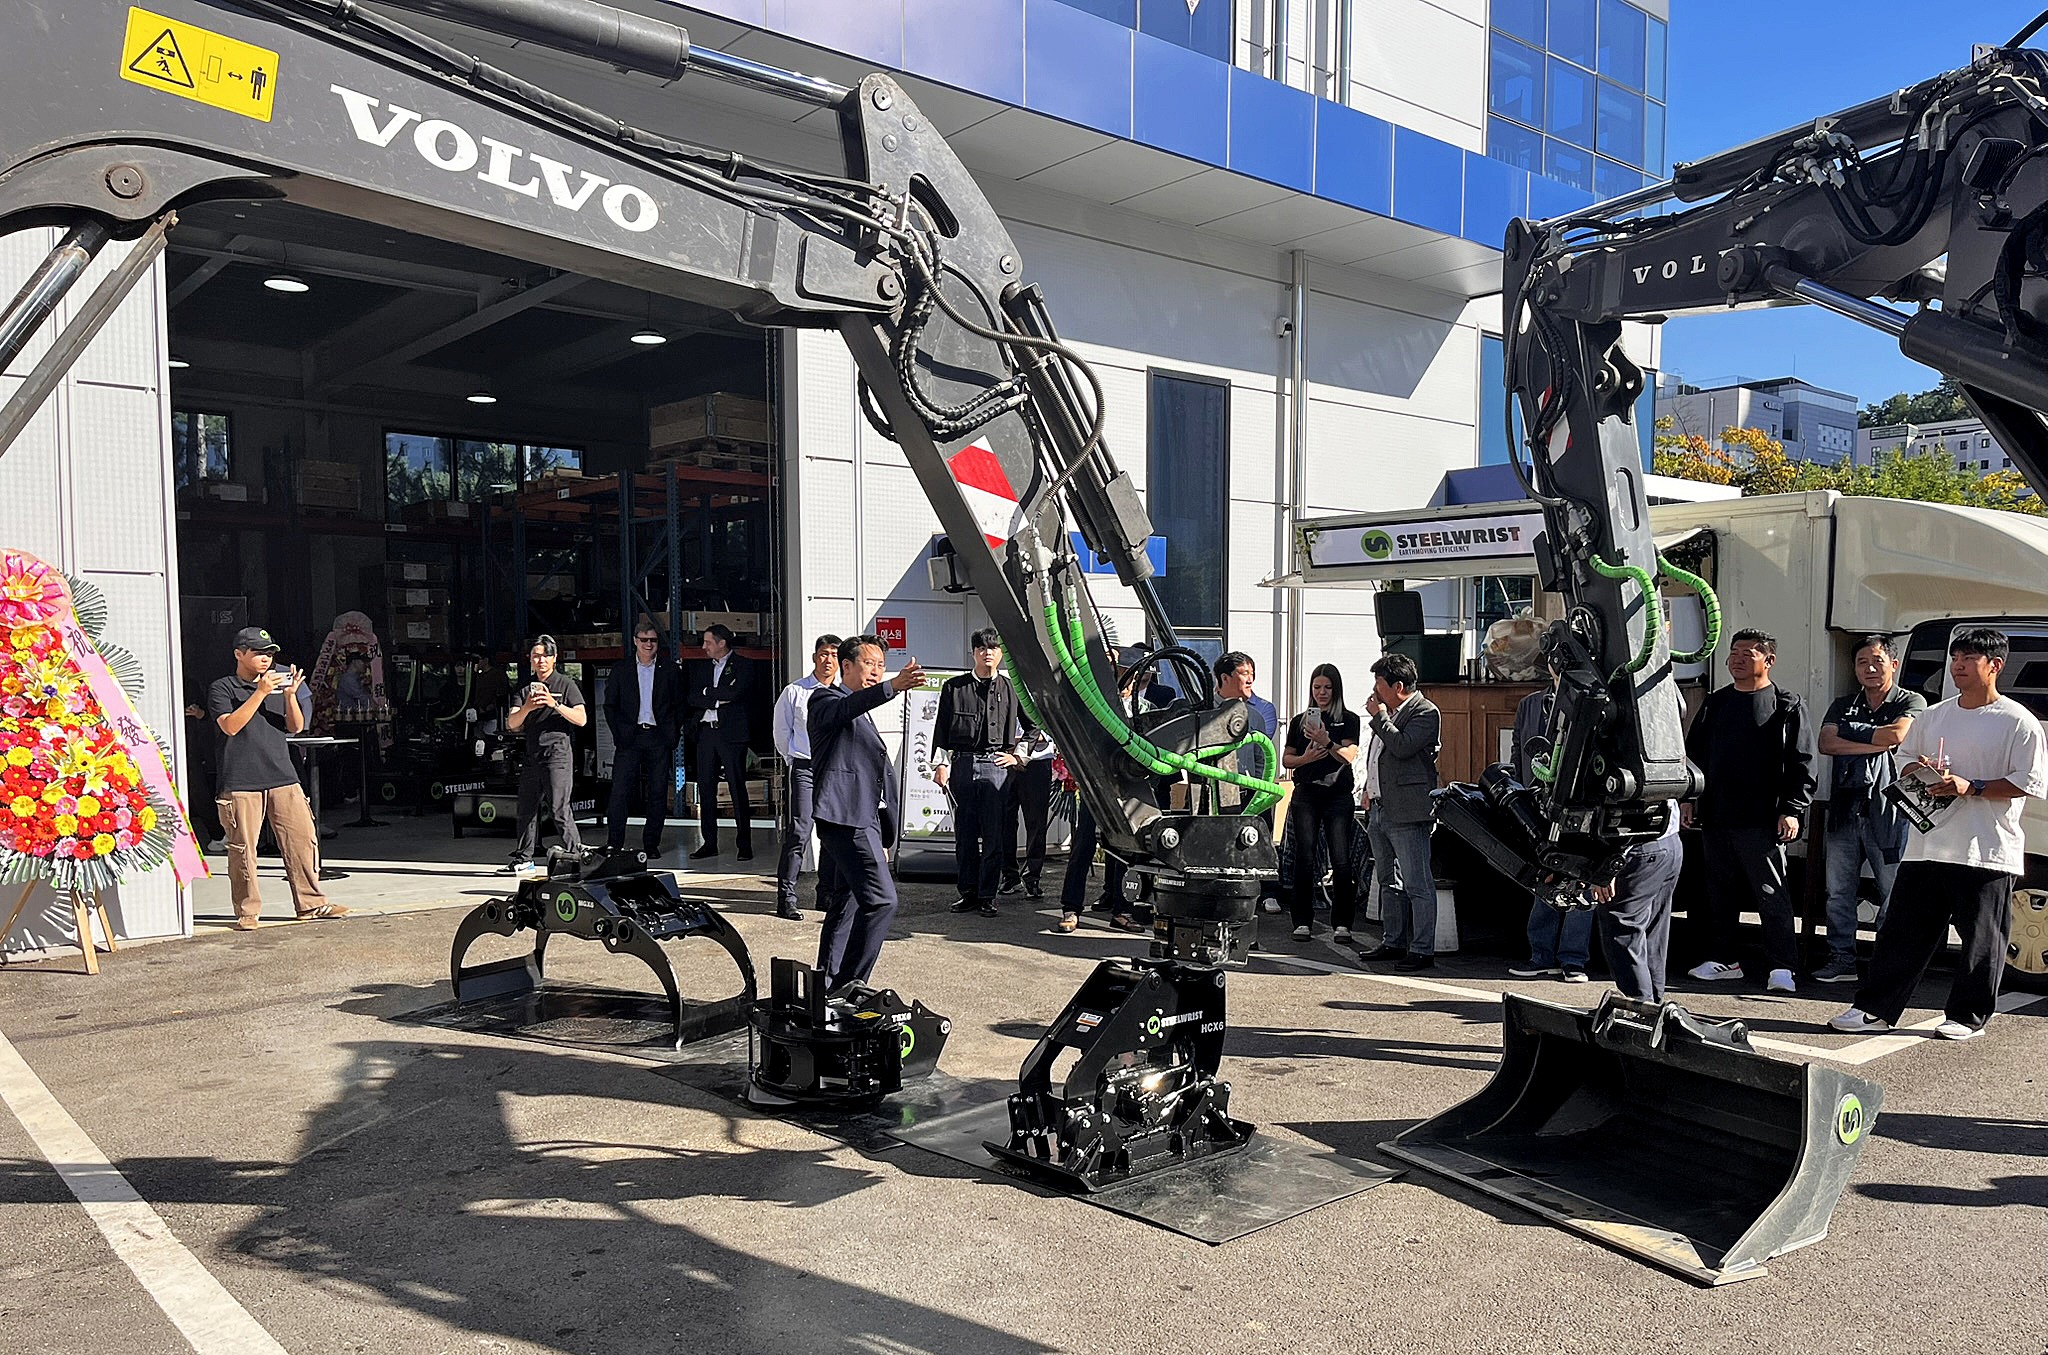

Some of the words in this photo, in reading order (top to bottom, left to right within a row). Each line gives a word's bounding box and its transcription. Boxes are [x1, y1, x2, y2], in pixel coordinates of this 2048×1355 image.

[330, 83, 659, 232] VOLVO
[1632, 242, 1766, 284] VOL
[1396, 526, 1520, 549] STEELWRIST
[1399, 546, 1437, 556] EARTHMOVING
[1439, 545, 1470, 553] EFFICIENCY
[572, 799, 596, 811] WRIST
[1125, 881, 1139, 890] XR7
[1161, 1010, 1204, 1028] STEELWRIST
[1201, 1021, 1225, 1034] HCX6
